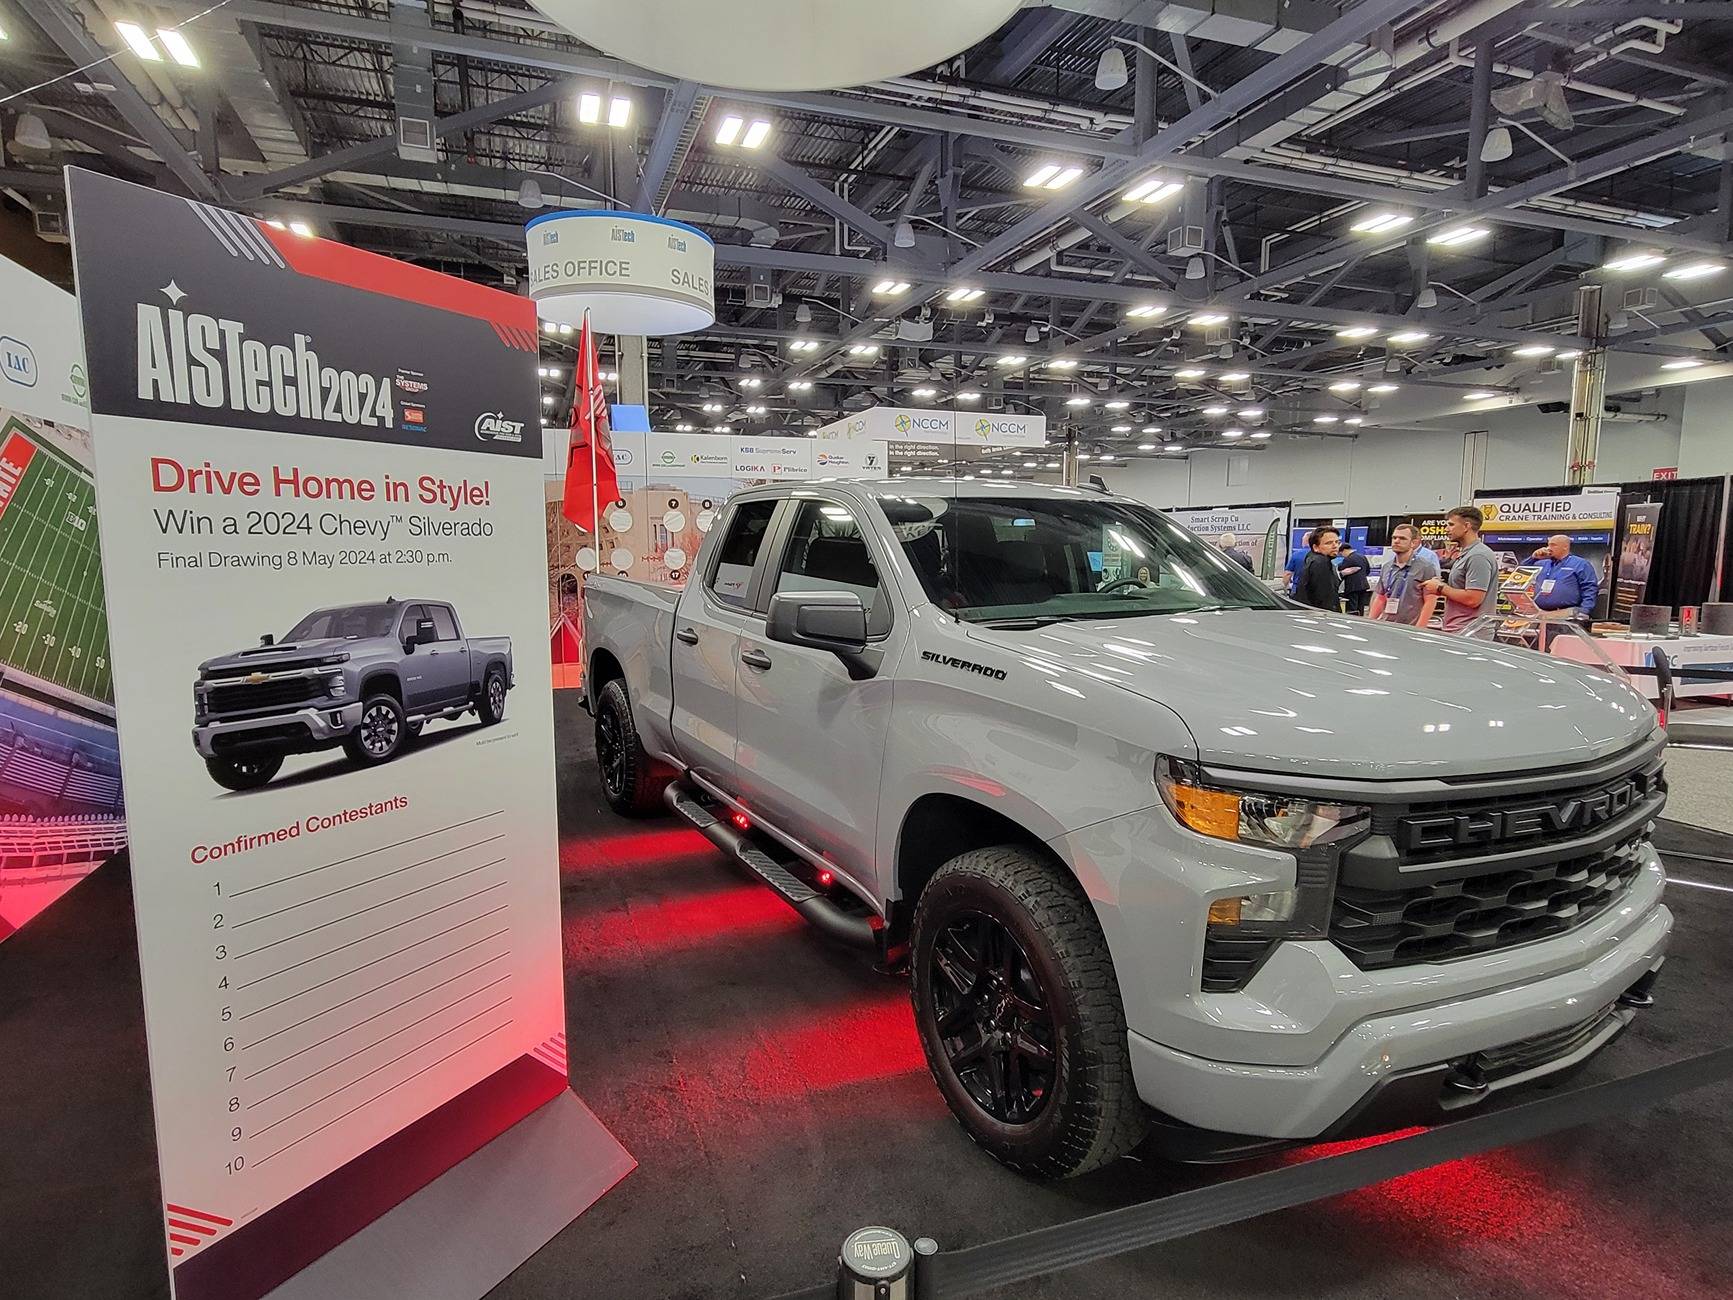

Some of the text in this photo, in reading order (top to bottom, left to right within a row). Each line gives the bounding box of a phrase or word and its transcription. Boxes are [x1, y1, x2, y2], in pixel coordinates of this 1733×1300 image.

[611, 226, 635, 243] AISTech
[667, 235, 687, 252] AISTech
[564, 260, 630, 278] OFFICE
[671, 268, 709, 296] SALES
[6, 351, 29, 374] IAC
[395, 379, 428, 390] SYSTEMS
[480, 418, 525, 434] AIST
[912, 418, 949, 430] NCCM
[991, 423, 1026, 434] NCCM
[615, 453, 627, 461] AC
[151, 457, 490, 511] Drive Home in Style!
[1653, 472, 1677, 481] EXIT
[1500, 502, 1572, 514] QUALIFIED
[153, 509, 213, 534] Win
[222, 516, 239, 534] a
[246, 511, 313, 535] 2024
[408, 516, 493, 537] Silverado
[1211, 515, 1229, 524] Scrap
[1532, 513, 1570, 521] TRAINING
[1210, 524, 1236, 532] Systems
[157, 550, 452, 570] Final Drawing 8 May 2024 at 2:30 p.m.
[921, 650, 1007, 680] SILVERADO
[1399, 758, 1666, 850] CHEVROLE
[191, 796, 409, 865] Confirmed Contestants
[213, 882, 221, 896] 1
[213, 914, 224, 929] 2
[215, 945, 227, 960] 3
[218, 976, 229, 990] 4
[221, 1006, 232, 1021] 5
[224, 1036, 235, 1051] 6
[226, 1066, 236, 1082] 7
[228, 1097, 240, 1112] 8
[231, 1127, 242, 1142] 9
[225, 1156, 245, 1175] 10
